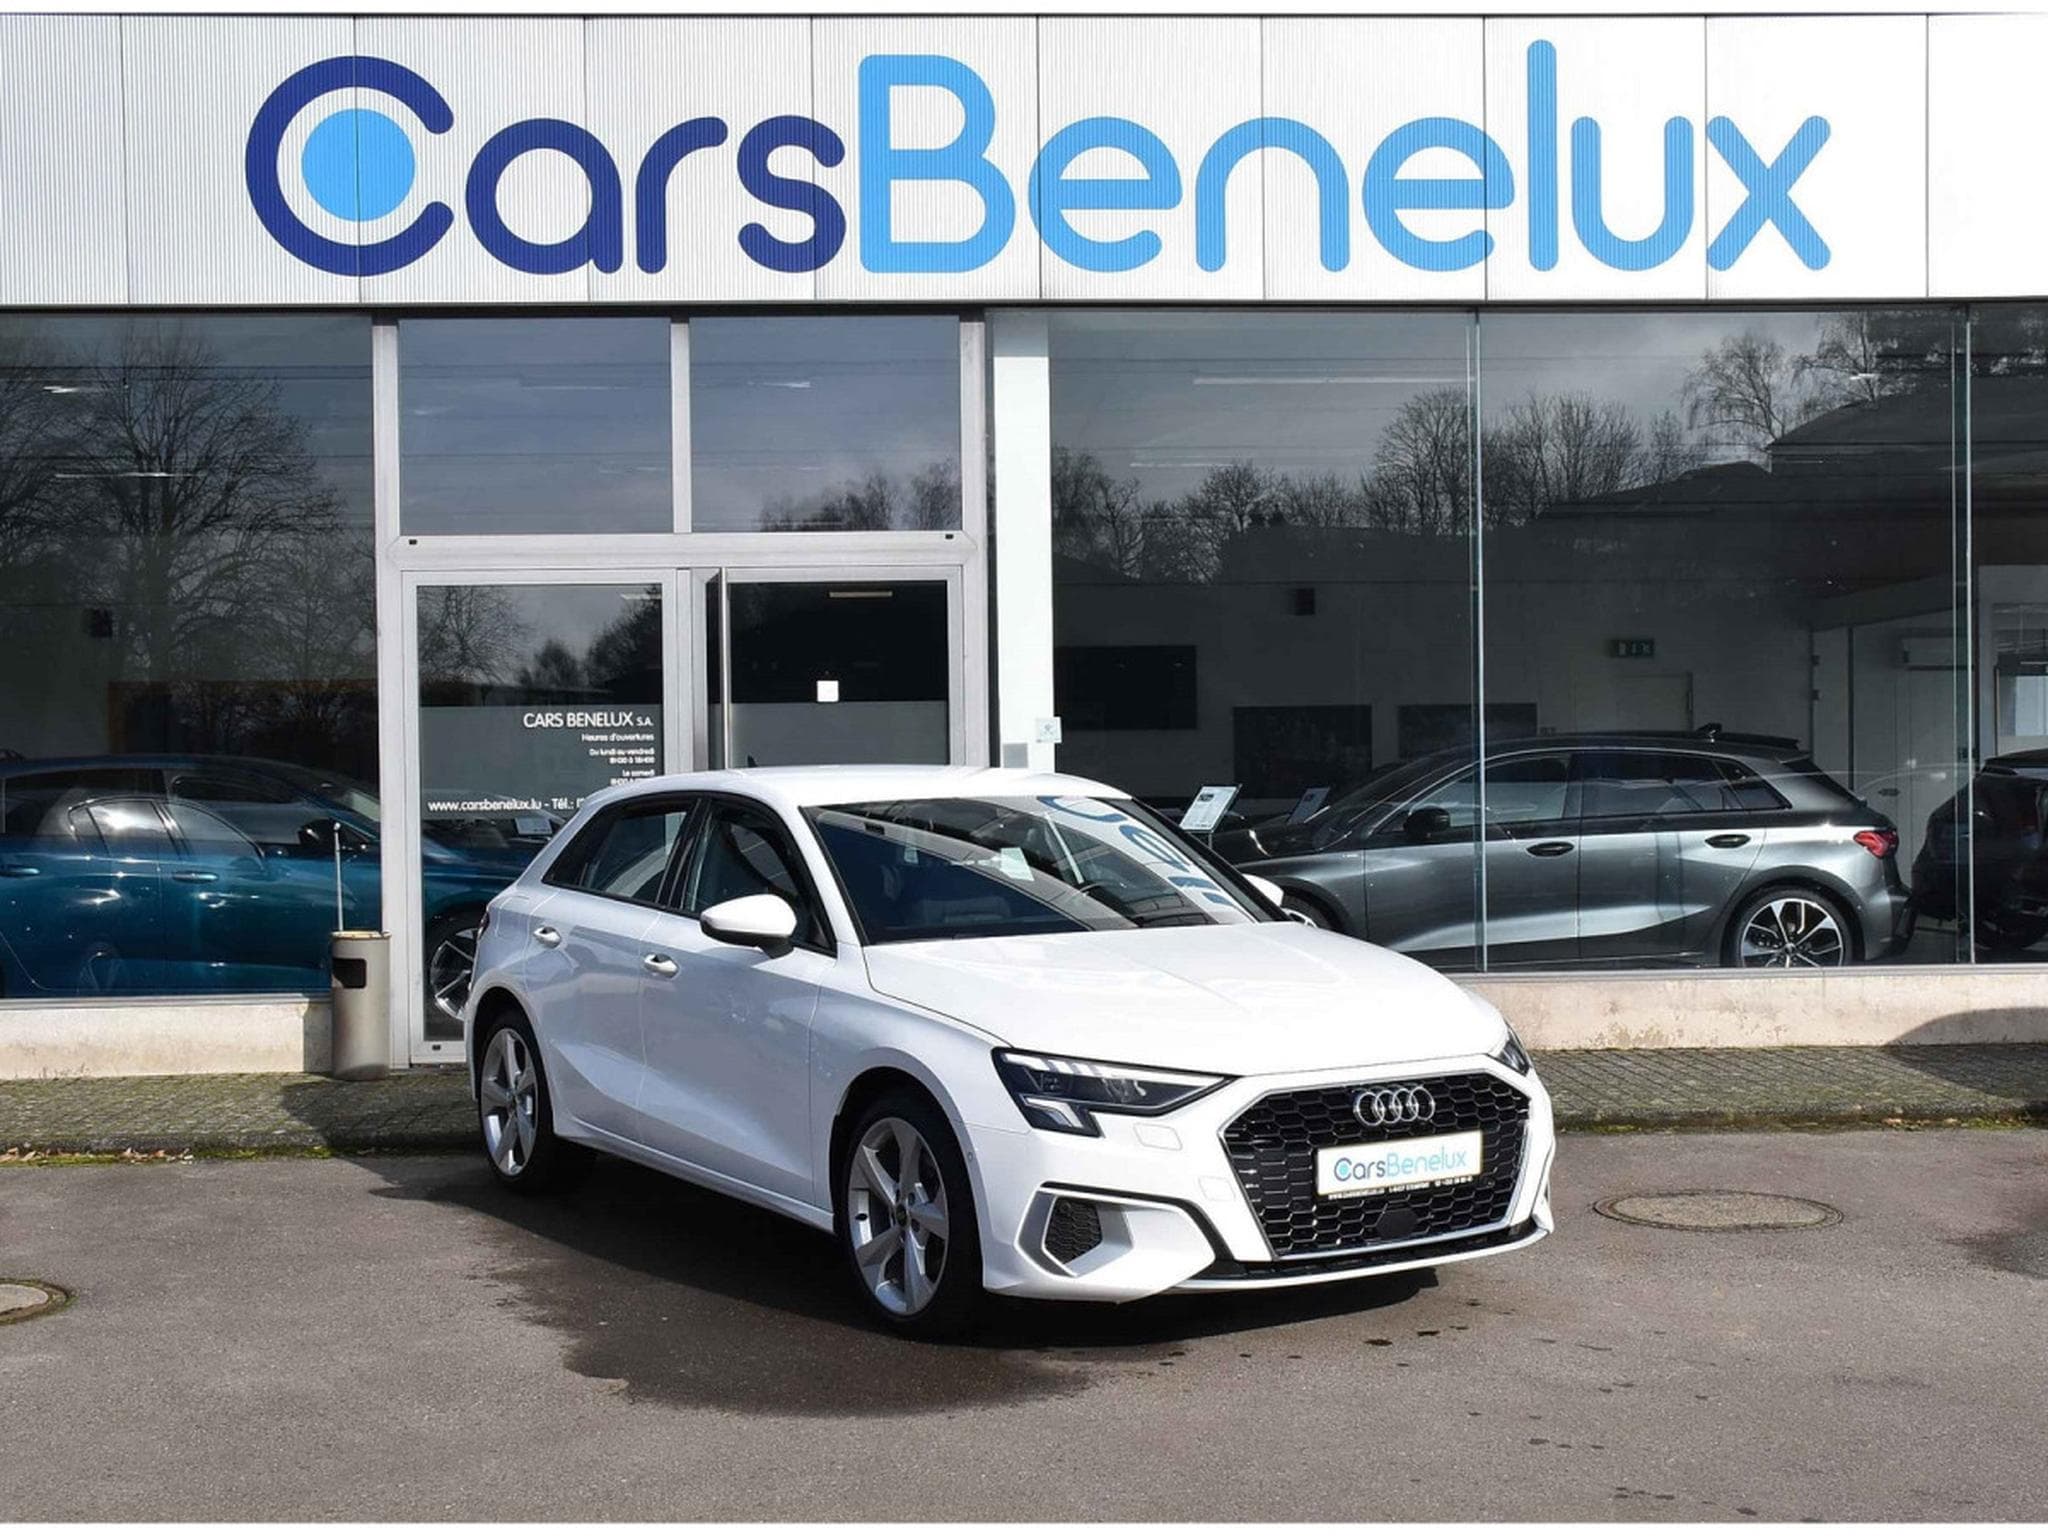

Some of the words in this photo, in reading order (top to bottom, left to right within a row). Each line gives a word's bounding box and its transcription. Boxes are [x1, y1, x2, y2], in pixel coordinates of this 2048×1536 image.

[245, 39, 1831, 276] CarsBenelux
[523, 712, 564, 728] CARS
[566, 711, 634, 727] BENELUX
[636, 716, 654, 726] S.A.
[581, 733, 609, 742] Heures
[428, 798, 542, 812] www.carsbenelux.lu
[1334, 1145, 1468, 1182] CarsBenelux
